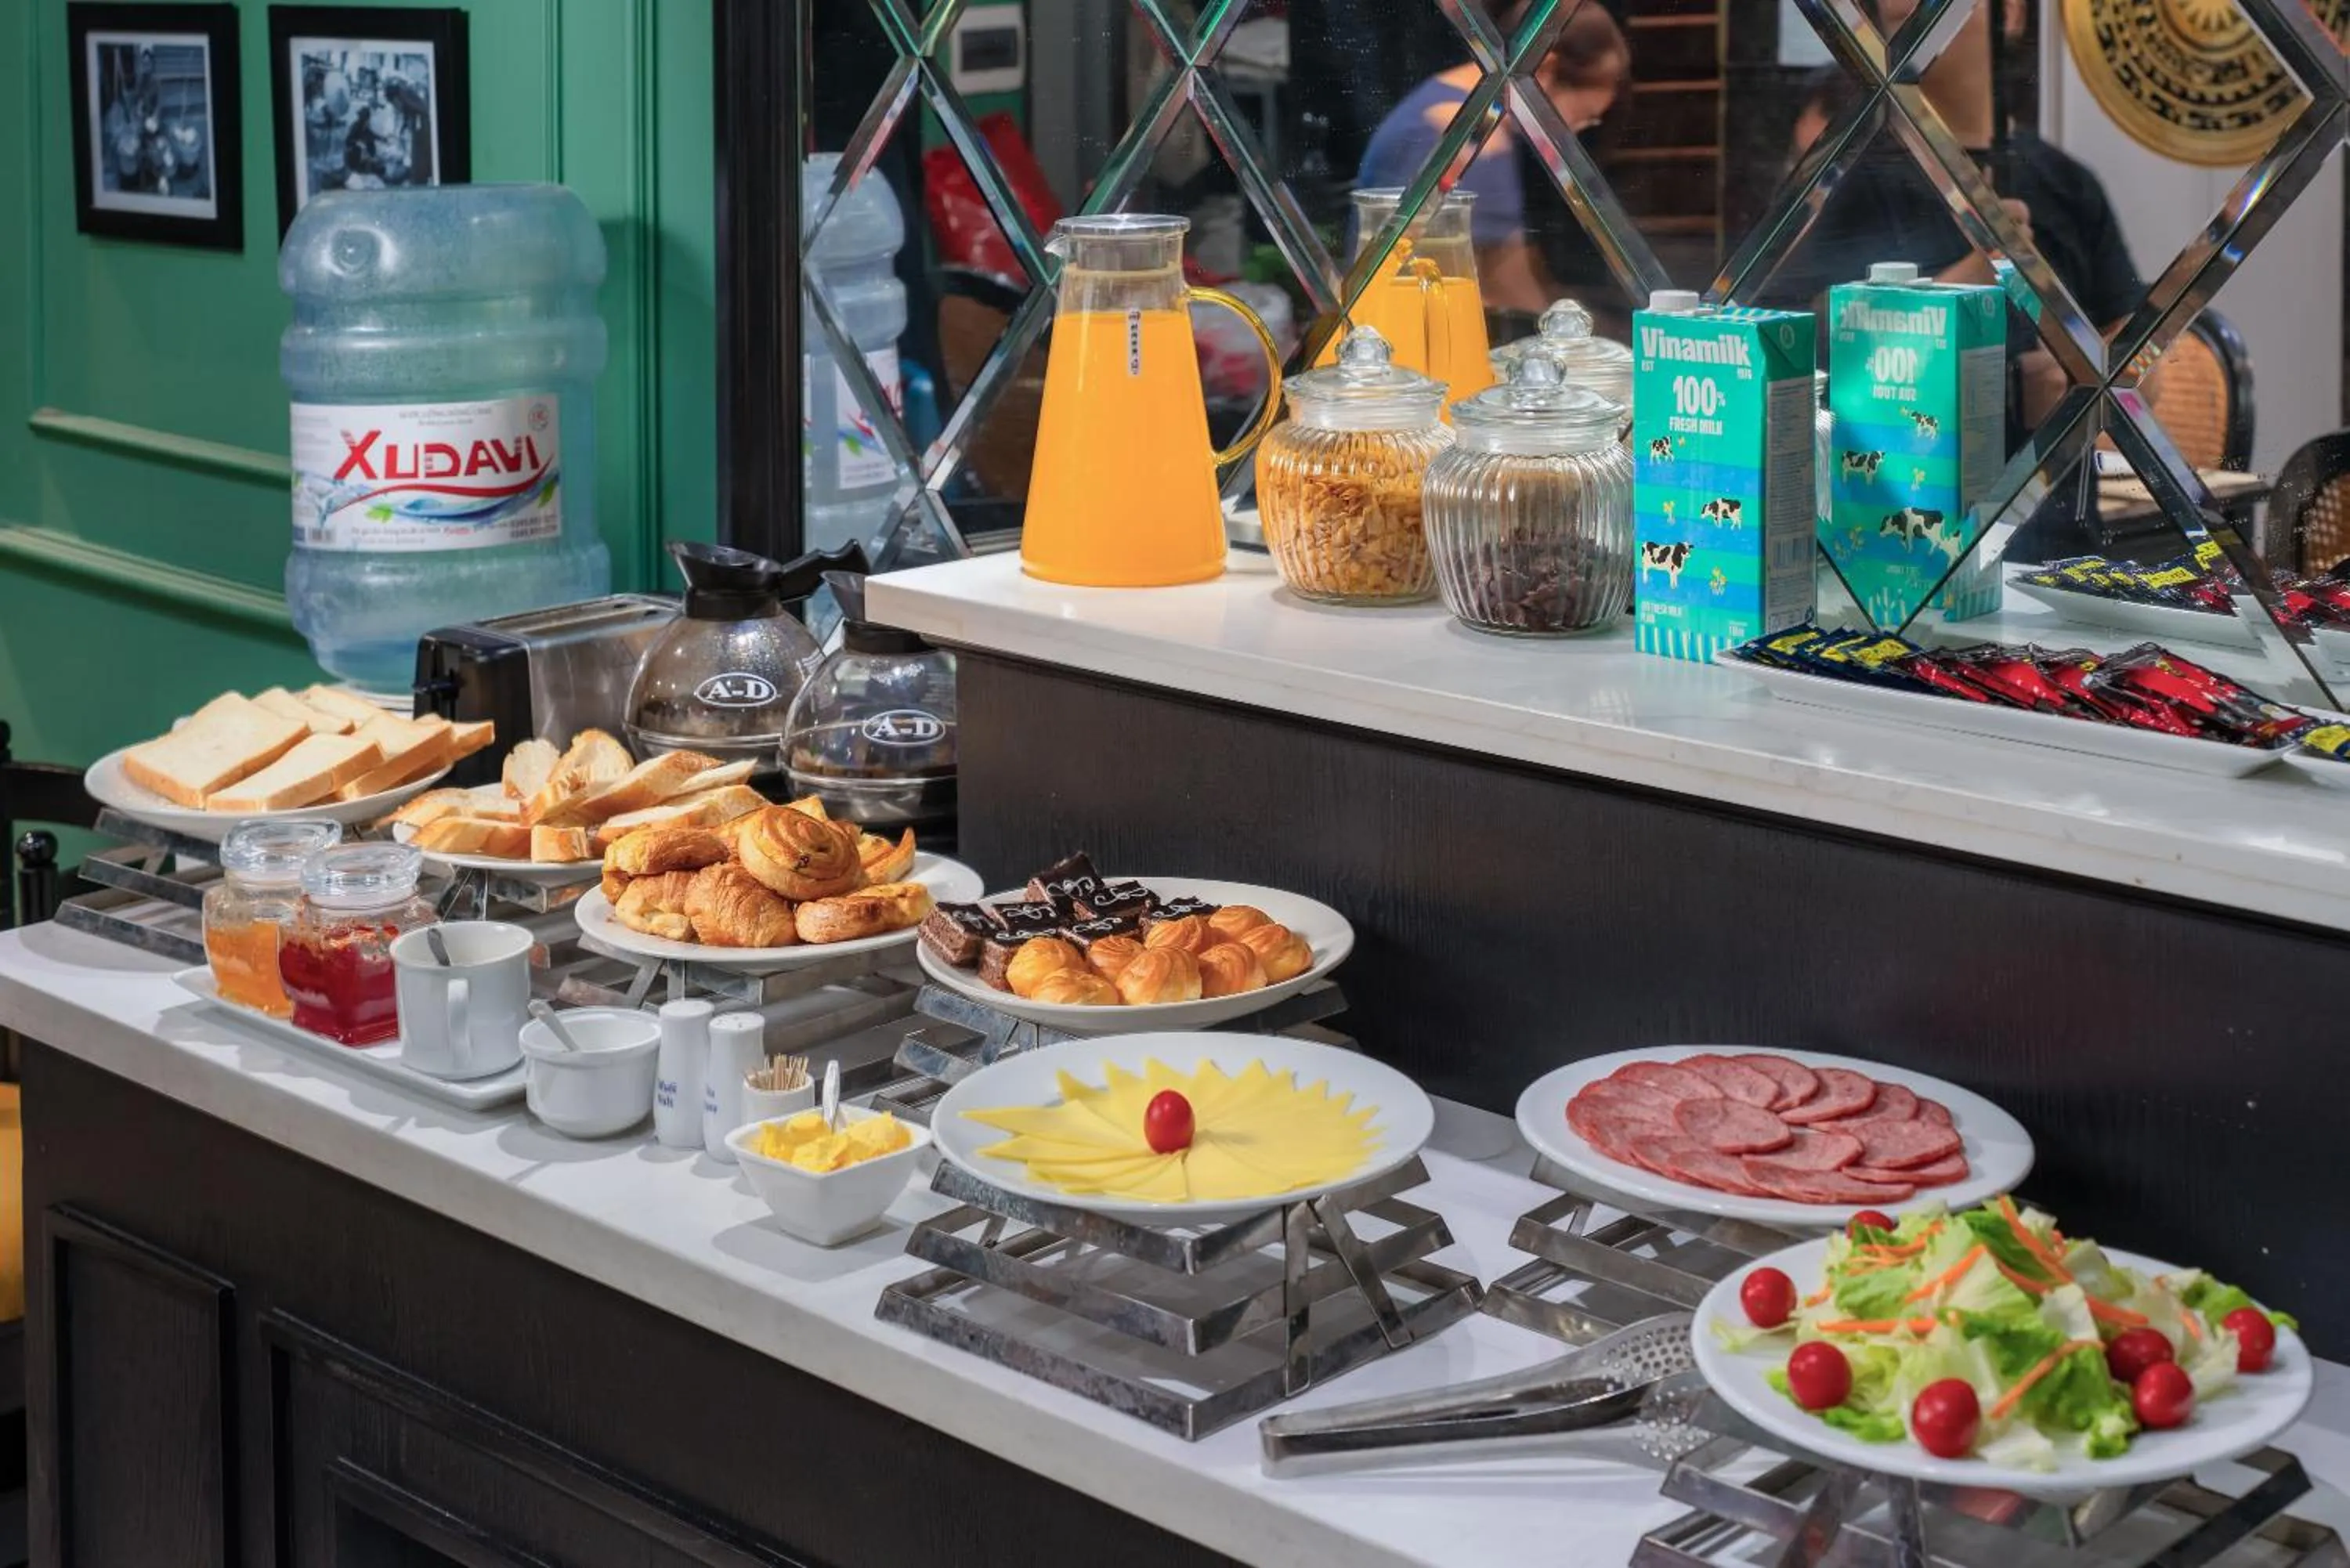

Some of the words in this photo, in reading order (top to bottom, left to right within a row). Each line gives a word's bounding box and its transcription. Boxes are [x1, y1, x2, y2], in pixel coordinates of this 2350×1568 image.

[1640, 326, 1752, 367] Vinamilk
[333, 430, 540, 480] XUDAVI
[707, 680, 770, 699] A-D
[871, 717, 938, 738] A-D
